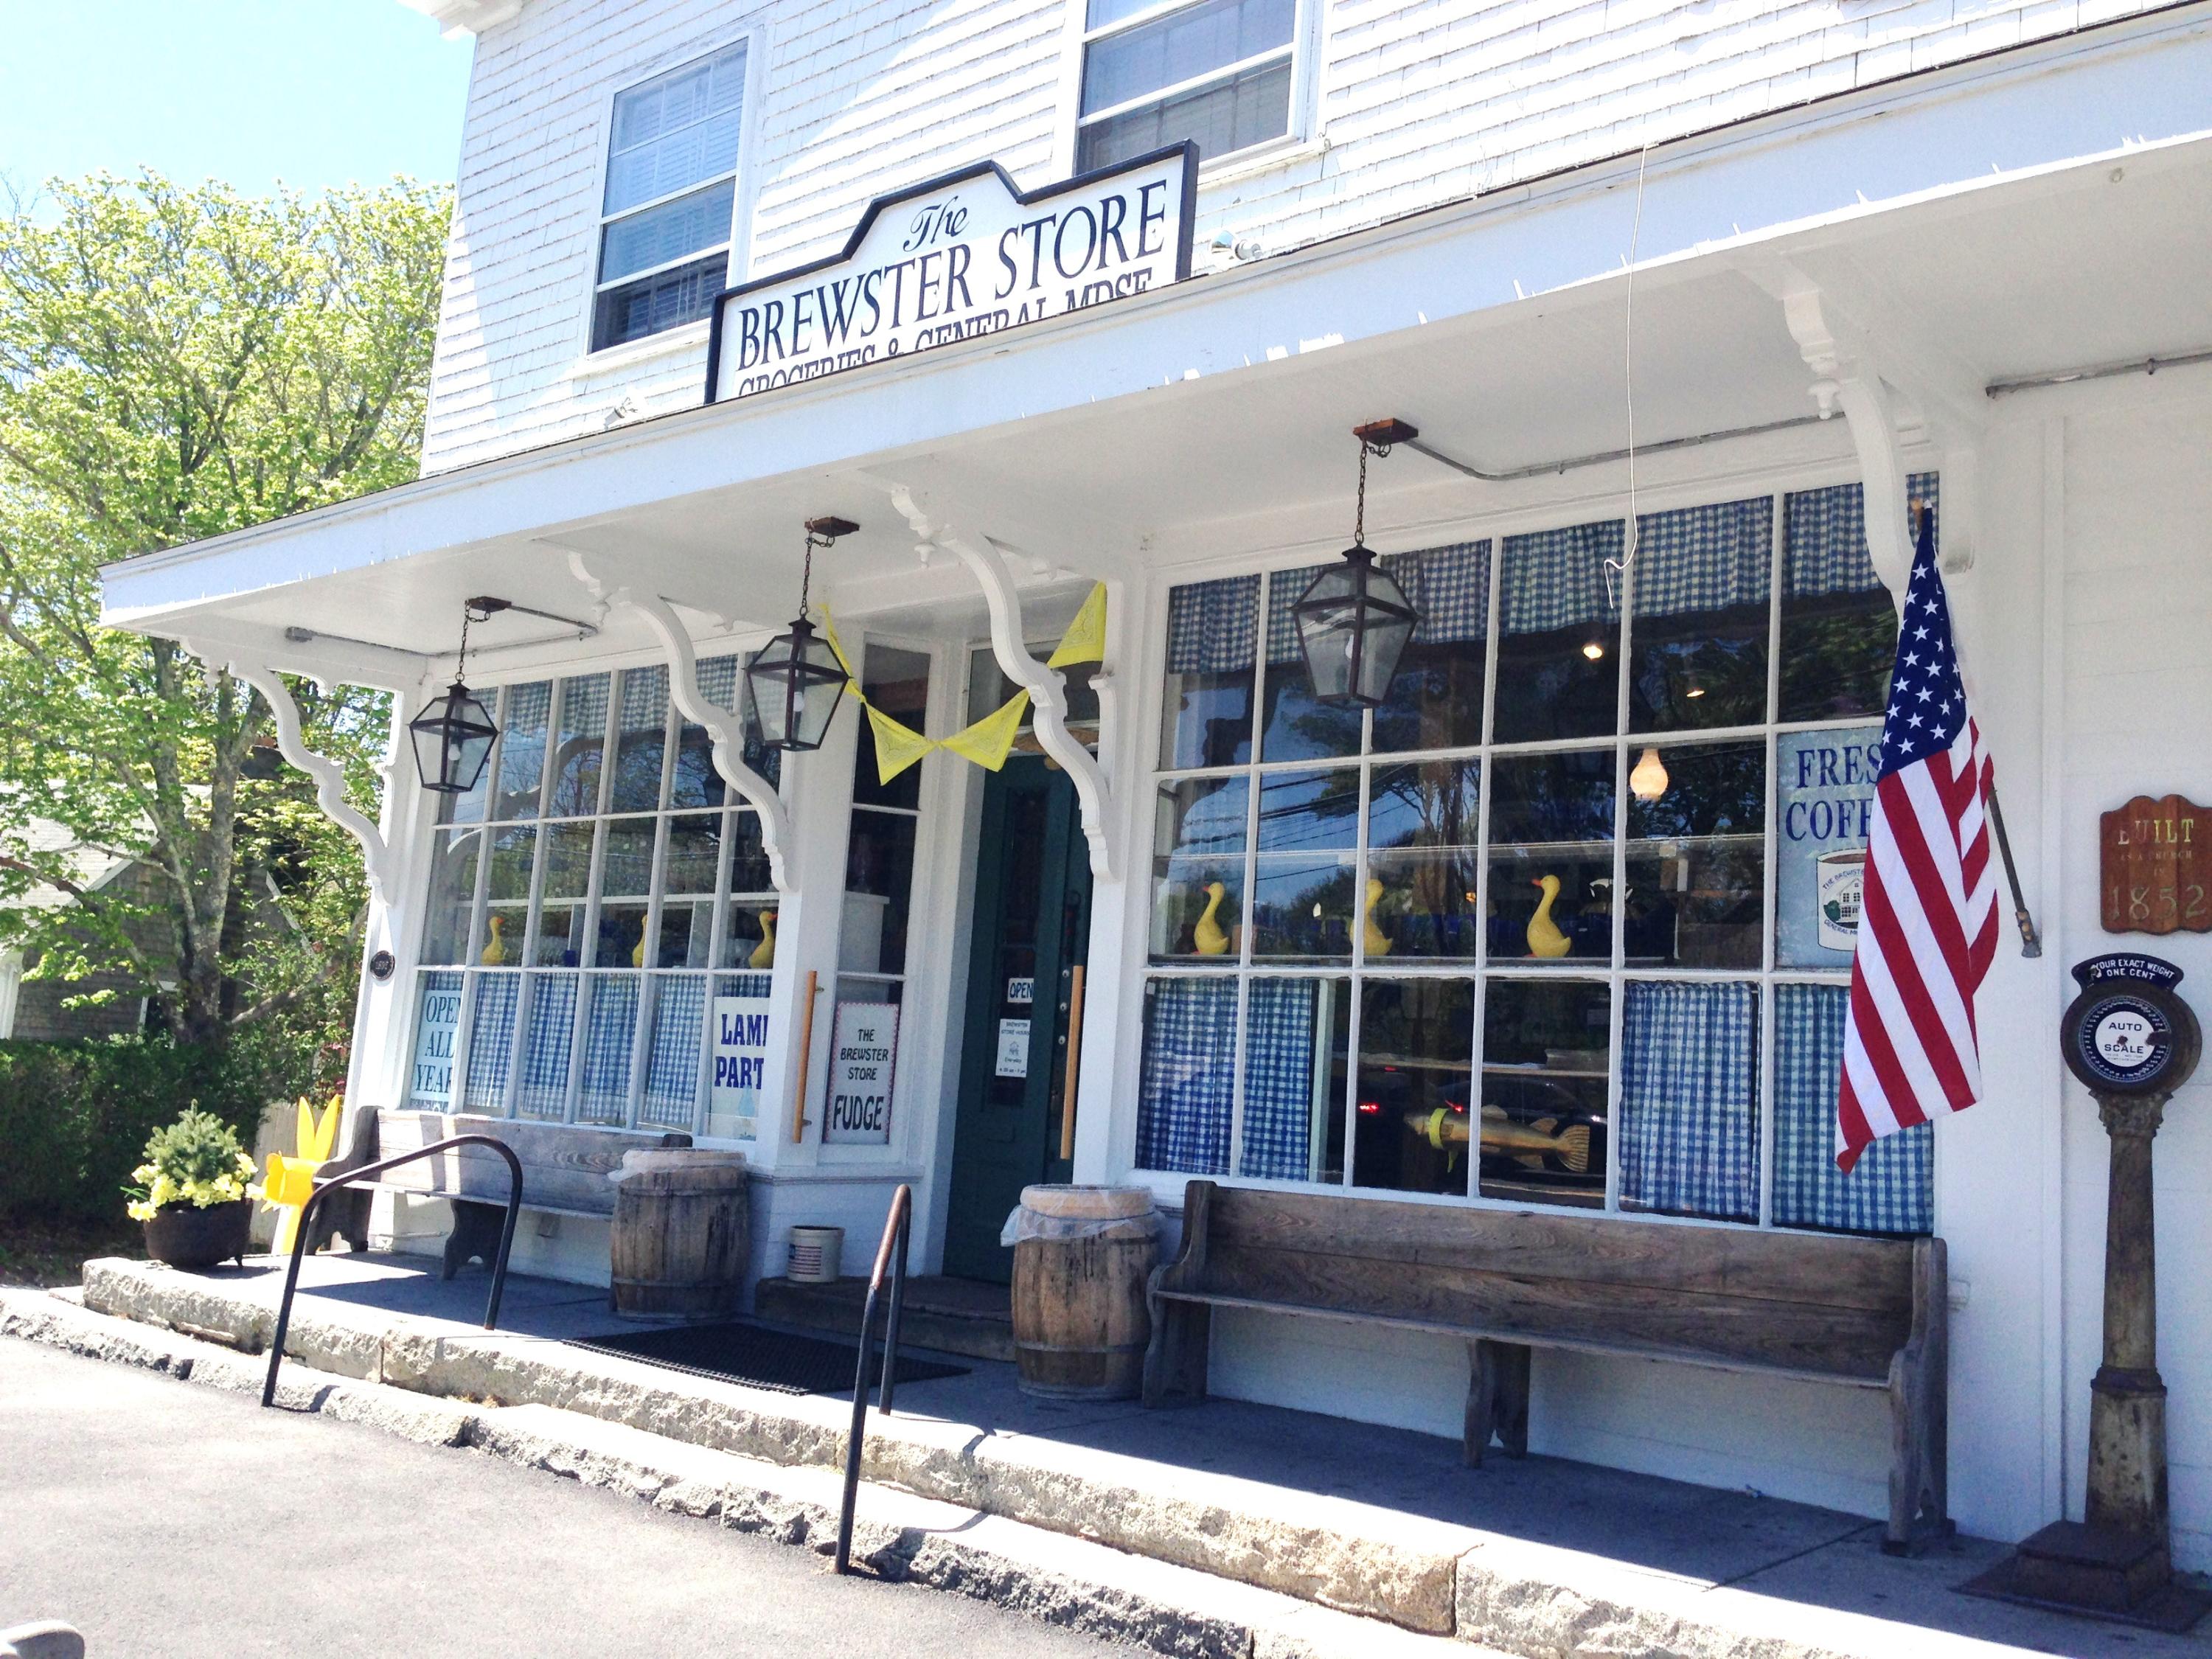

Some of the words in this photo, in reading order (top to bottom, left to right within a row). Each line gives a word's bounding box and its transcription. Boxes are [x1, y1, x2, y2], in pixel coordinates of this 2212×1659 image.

[902, 195, 969, 252] The
[736, 243, 973, 372] BREWSTER
[995, 178, 1166, 300] STORE
[1796, 743, 1882, 788] FRES
[1785, 799, 1873, 841] COFF
[1834, 869, 1864, 880] BREWSTE
[2112, 885, 2207, 920] 1852
[2094, 959, 2116, 970] YOUR
[2118, 959, 2146, 968] EXACT
[2147, 962, 2175, 978] WEIGHT
[2107, 968, 2125, 977] ONE
[2129, 968, 2156, 980] CENT
[1009, 982, 1033, 999] OPEN
[857, 1029, 875, 1042] THE
[2108, 1022, 2142, 1032] AUTO
[425, 1031, 455, 1058] ALL
[2104, 1044, 2144, 1054] SCALE
[840, 1048, 888, 1061] BREWSTER
[714, 1056, 765, 1090] PART
[848, 1067, 877, 1081] STORE
[832, 1094, 885, 1130] FUDGE
